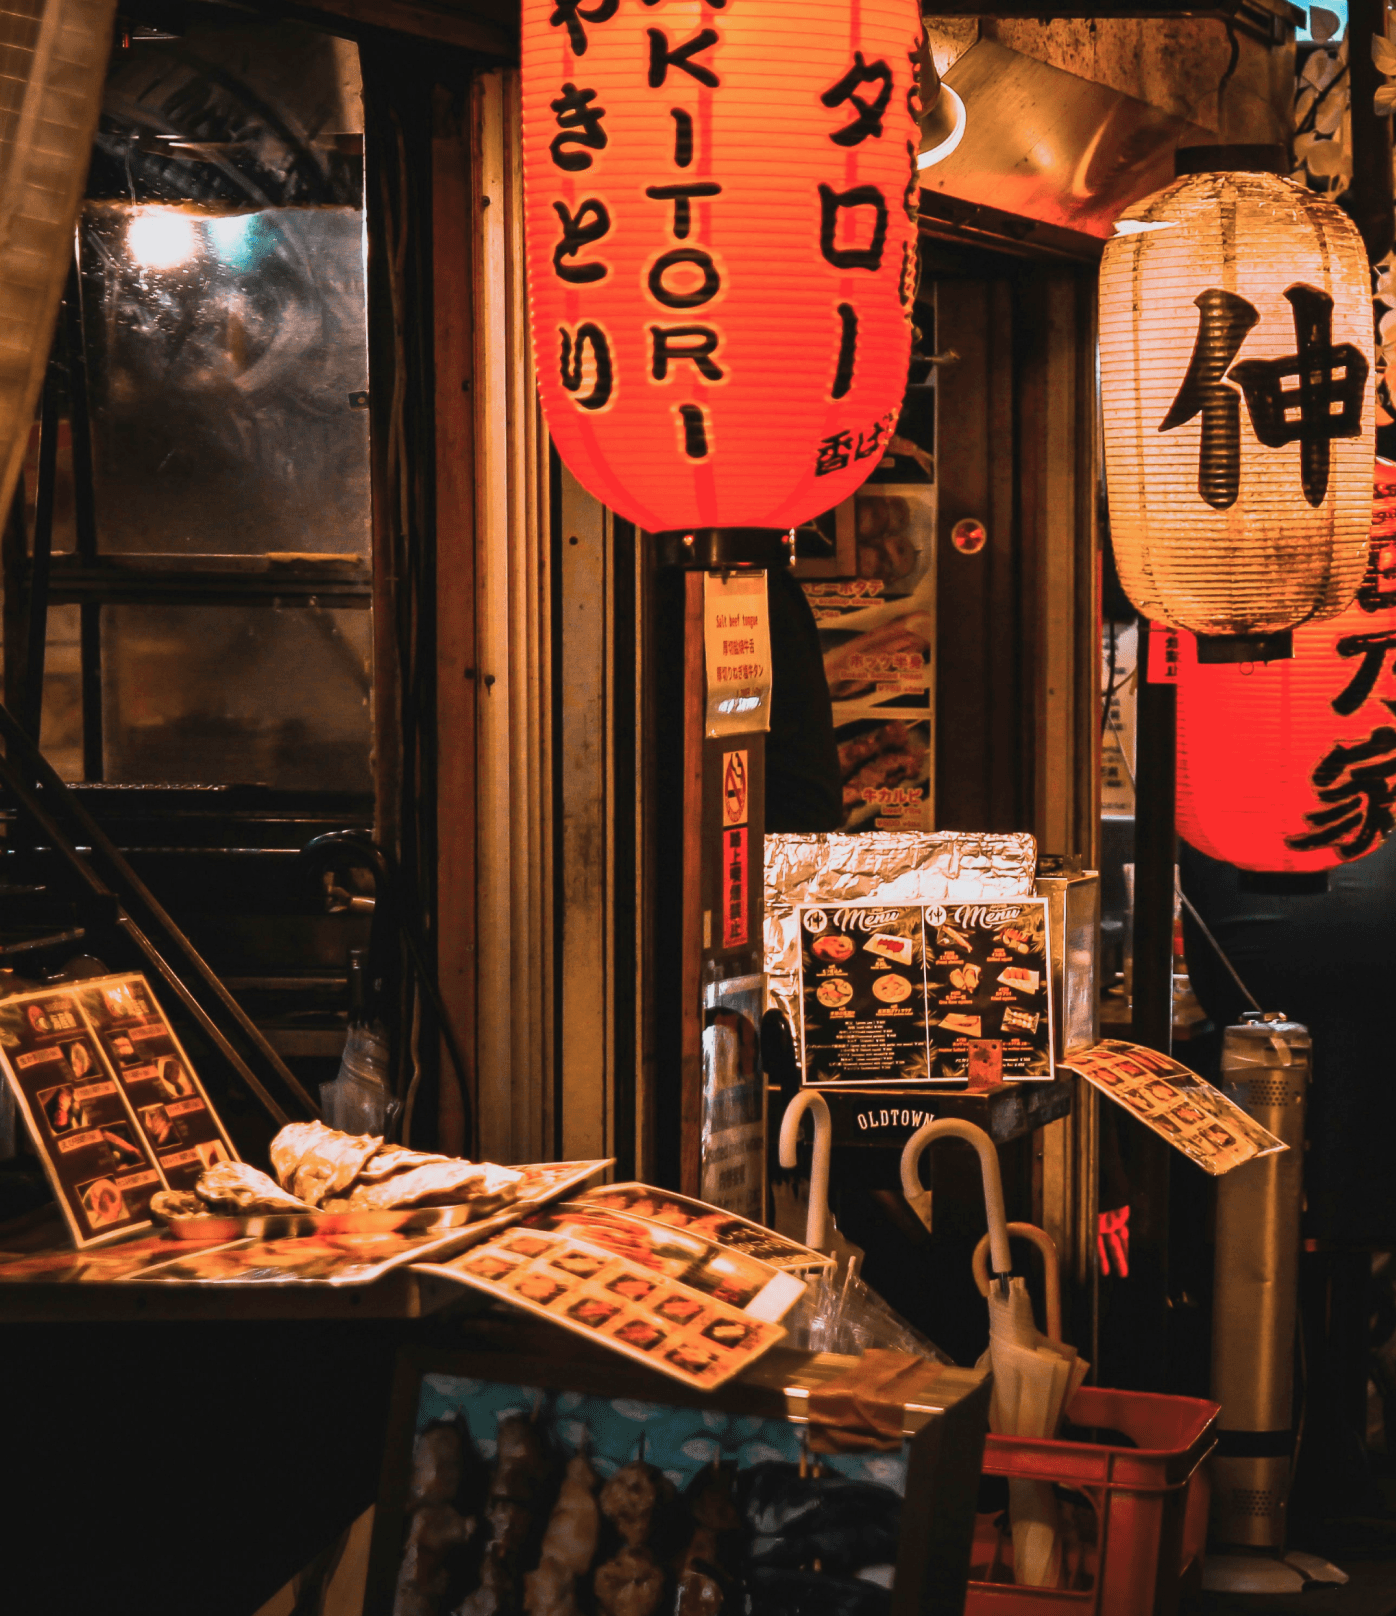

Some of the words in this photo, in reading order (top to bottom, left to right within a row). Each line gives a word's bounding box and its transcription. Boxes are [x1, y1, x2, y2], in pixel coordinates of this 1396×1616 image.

[646, 0, 727, 459] KITORI
[818, 50, 894, 400] タロー
[728, 613, 740, 628] beef
[833, 907, 899, 932] Menu
[954, 905, 1021, 929] Menu
[857, 1108, 935, 1130] OLDTOWN
